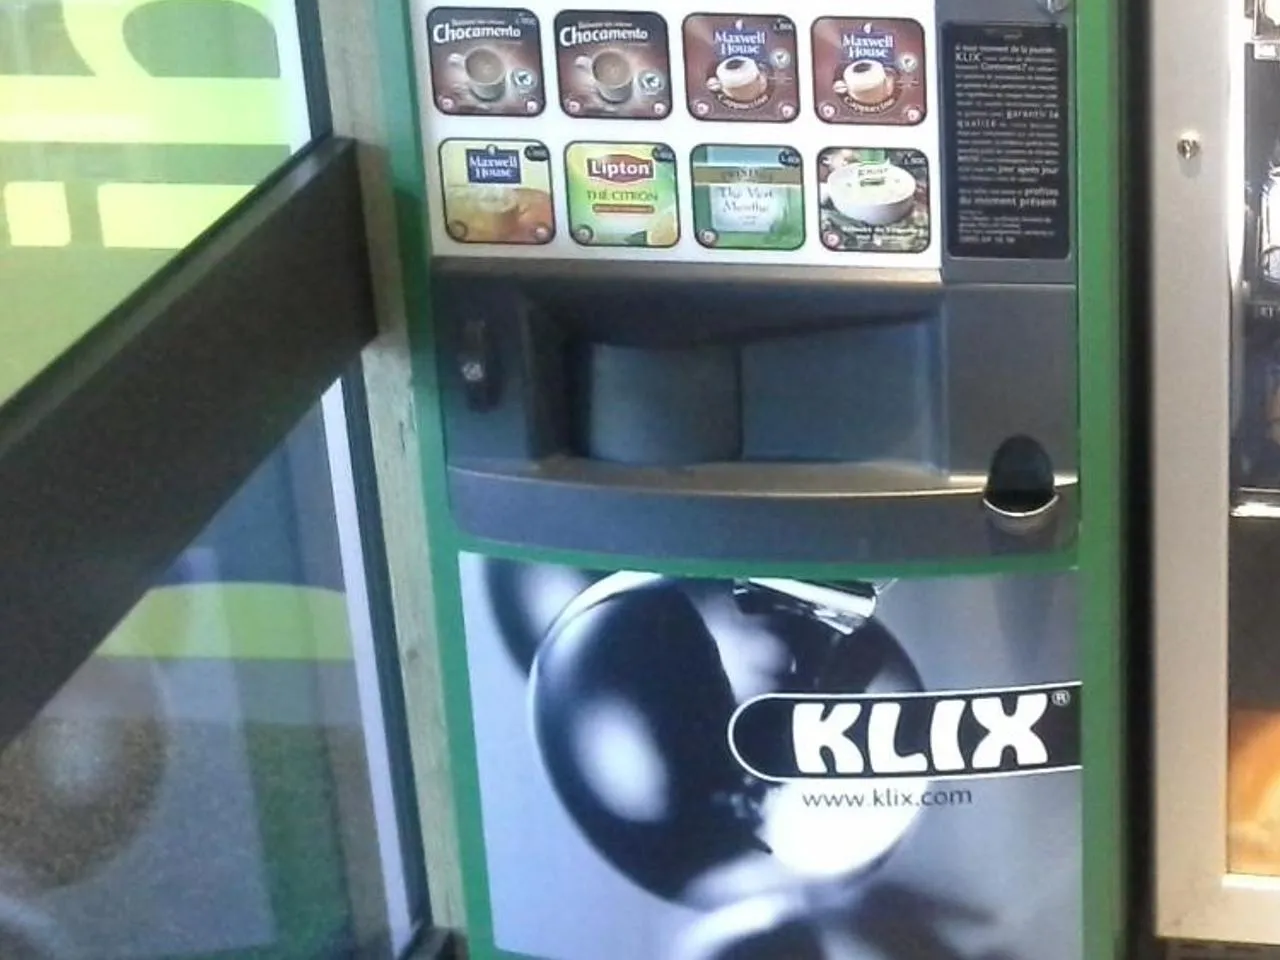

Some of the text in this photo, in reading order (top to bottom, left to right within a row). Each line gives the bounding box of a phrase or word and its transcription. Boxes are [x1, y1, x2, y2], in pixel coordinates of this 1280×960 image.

[433, 23, 521, 44] Chocamento
[560, 26, 648, 47] Chocamento
[713, 31, 765, 45] Maxwell
[719, 42, 761, 56] House
[842, 35, 894, 49] Maxwell
[847, 46, 889, 59] House
[469, 155, 518, 169] Maxwell
[592, 159, 650, 178] Lipton
[802, 788, 973, 808] www.klix.com
